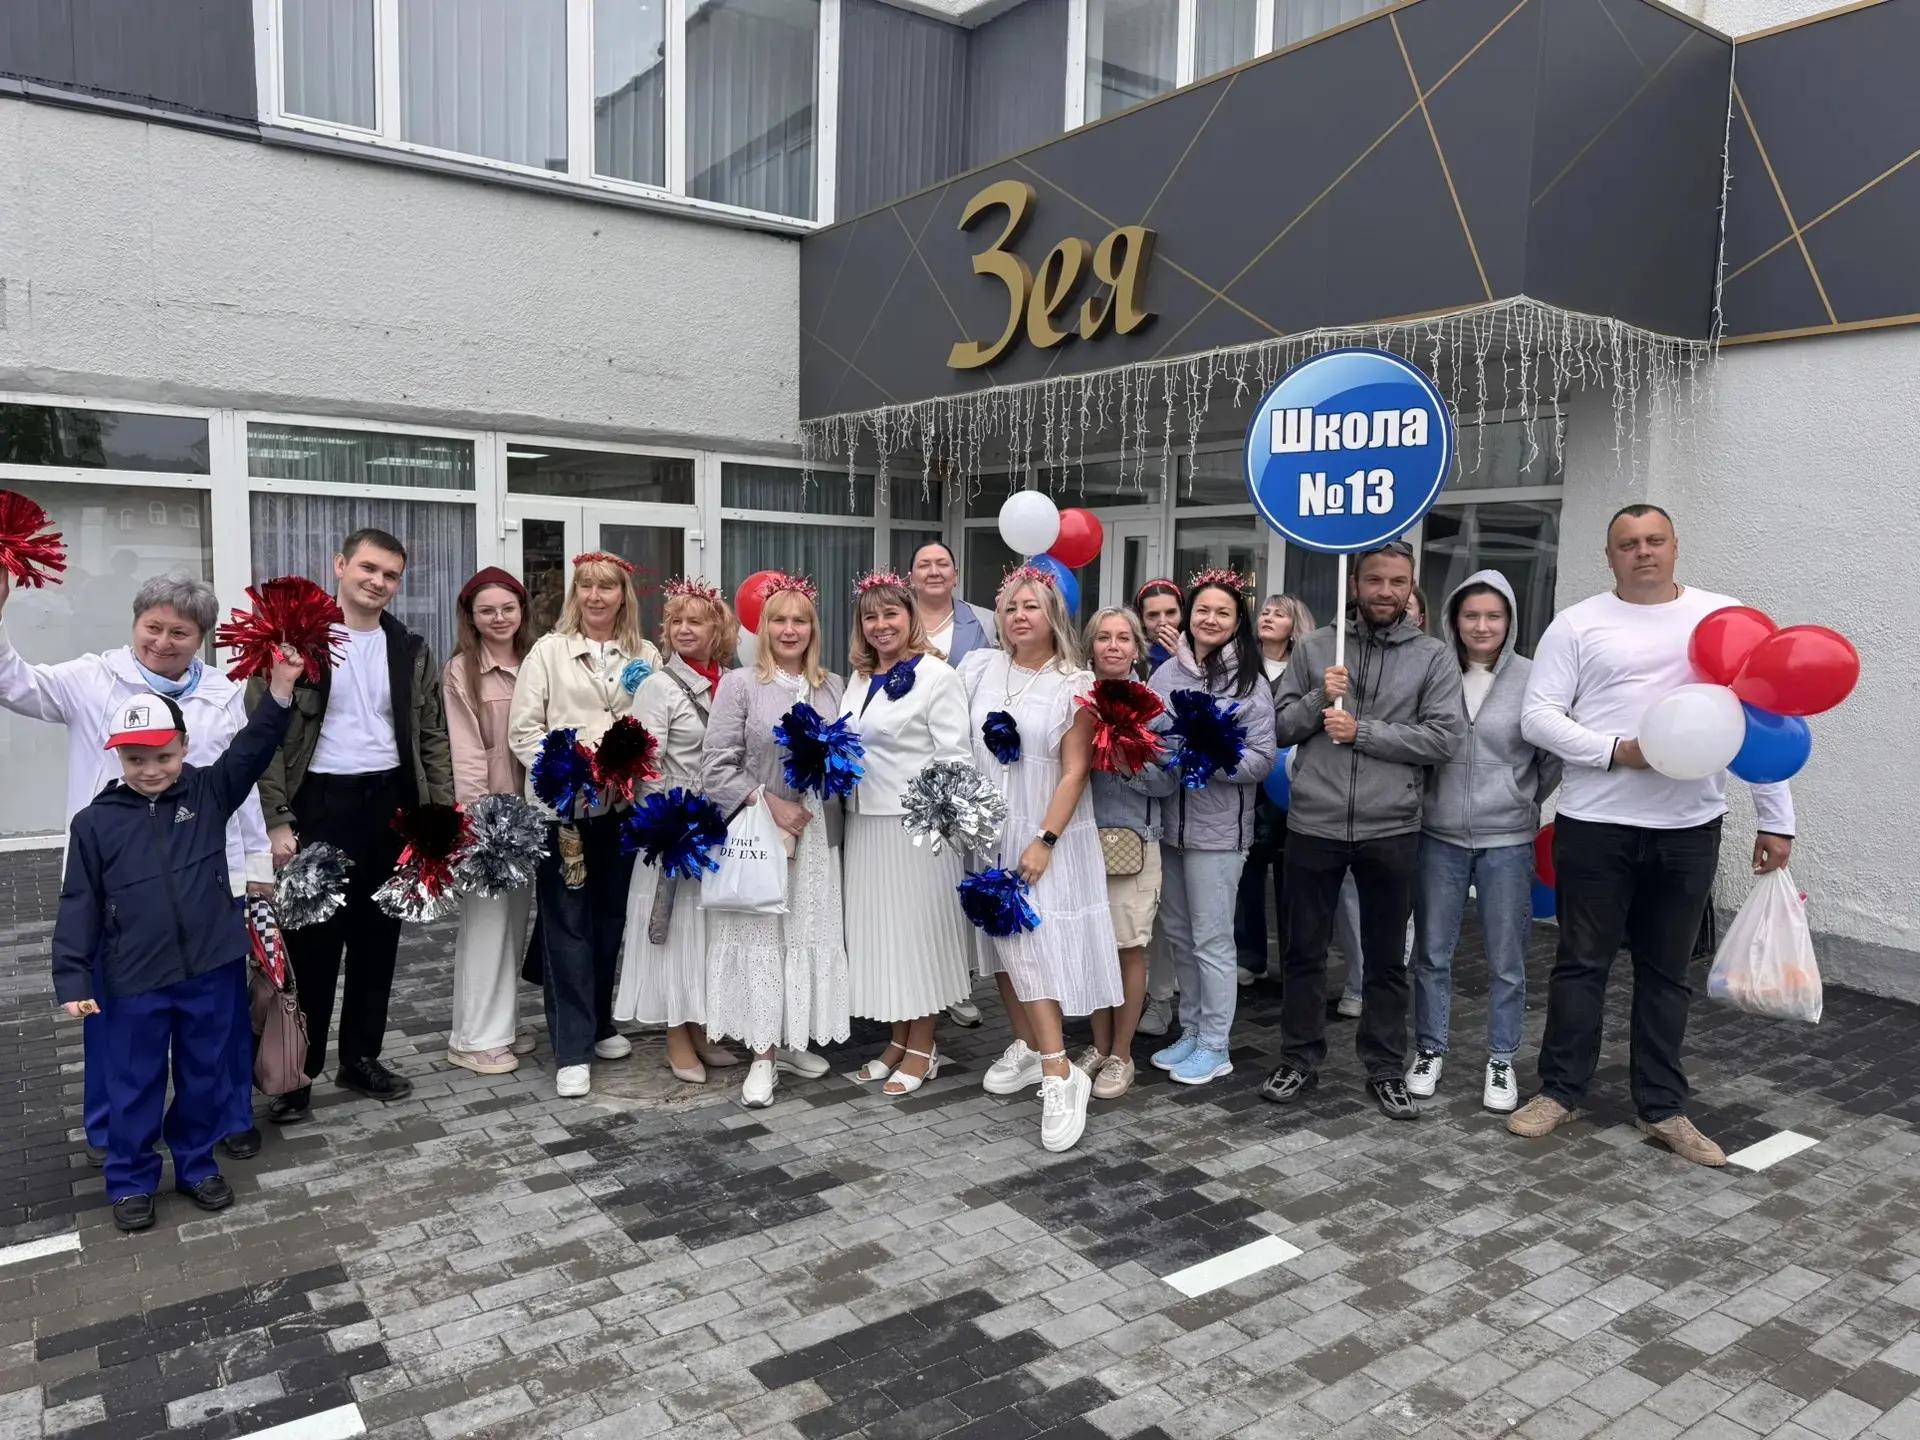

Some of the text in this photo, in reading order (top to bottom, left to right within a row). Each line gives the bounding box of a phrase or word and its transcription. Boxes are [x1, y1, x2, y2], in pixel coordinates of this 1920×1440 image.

[947, 180, 1154, 369] Зея
[1270, 407, 1429, 454] Школа
[1298, 469, 1395, 516] №13
[720, 847, 735, 858] DE
